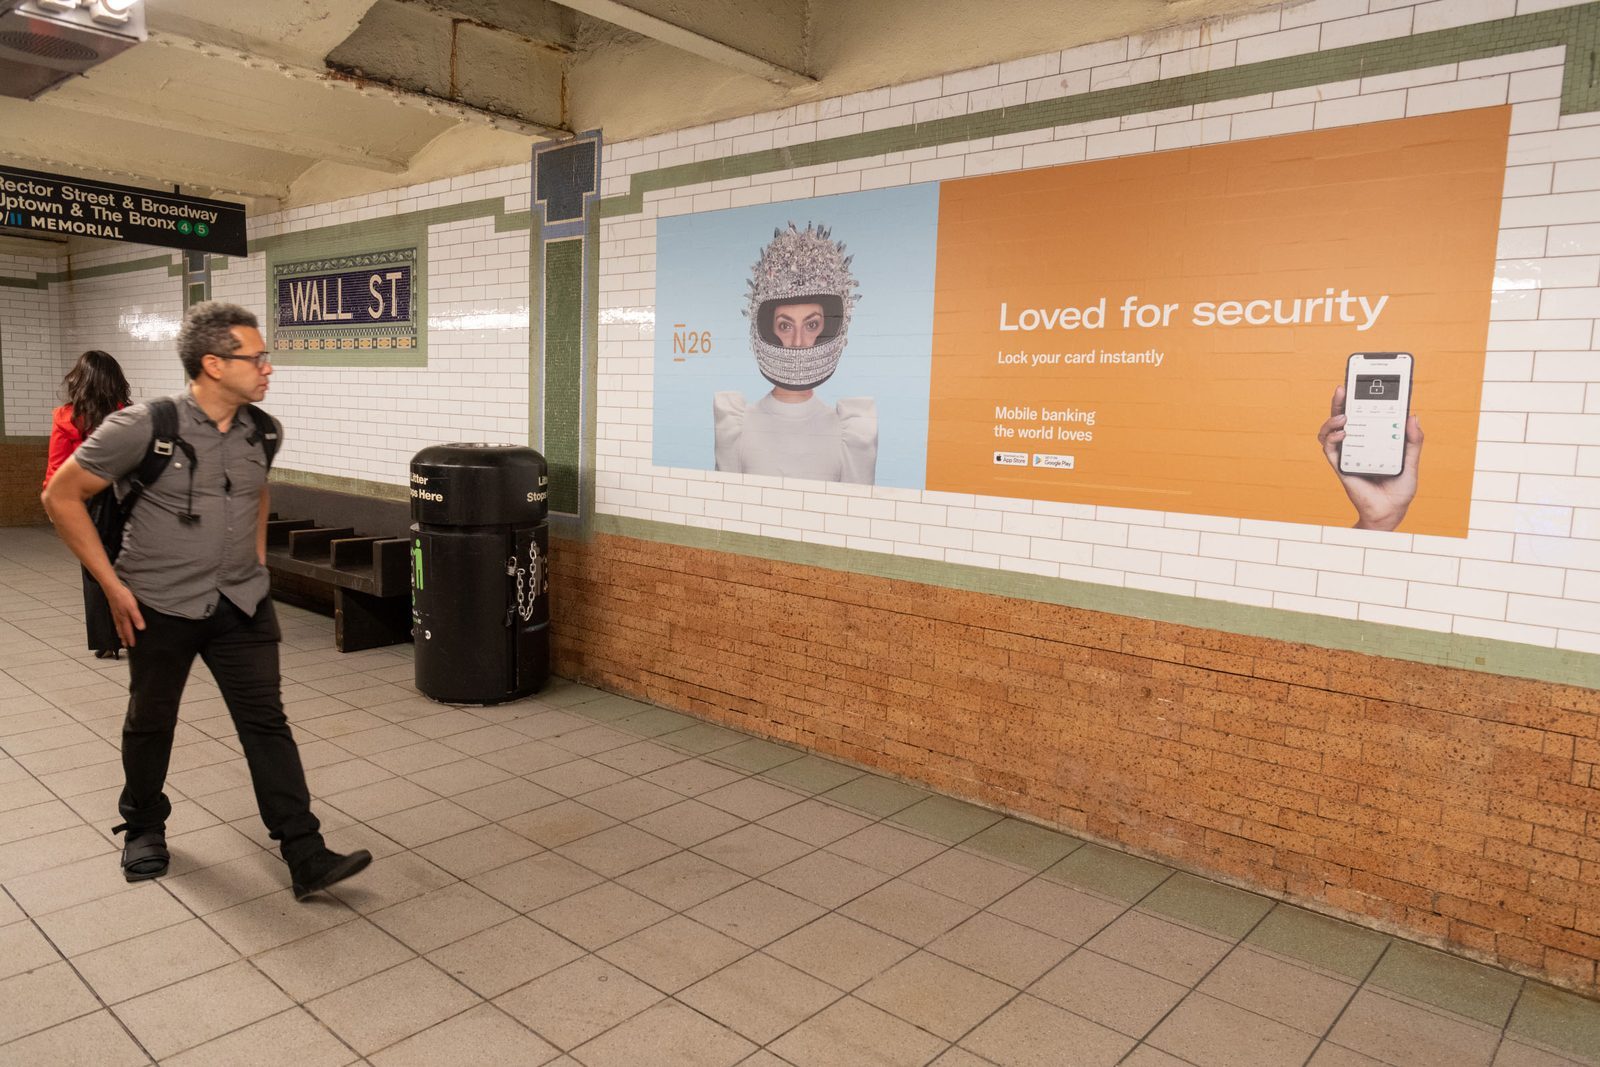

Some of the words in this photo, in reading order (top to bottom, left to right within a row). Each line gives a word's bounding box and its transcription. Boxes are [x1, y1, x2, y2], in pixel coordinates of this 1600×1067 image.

[61, 185, 116, 207] Street
[122, 195, 135, 210] &
[141, 198, 218, 224] Broadway
[70, 202, 84, 217] &
[90, 205, 123, 222] The
[129, 211, 176, 231] Bronx
[31, 215, 124, 239] MEMORIAL
[289, 278, 353, 322] WALL
[368, 271, 402, 319] ST
[999, 297, 1106, 331] Loved
[1120, 295, 1179, 328] for
[1191, 287, 1390, 332] security
[673, 324, 712, 362] N26
[997, 350, 1028, 364] Lock
[1031, 352, 1061, 367] your
[1064, 350, 1096, 364] card
[1100, 349, 1164, 367] instantly
[995, 406, 1038, 420] Mobile
[1041, 407, 1097, 426] banking
[993, 424, 1015, 438] the
[1017, 425, 1053, 440] world
[1057, 426, 1093, 442] loves
[419, 488, 444, 502] Here
